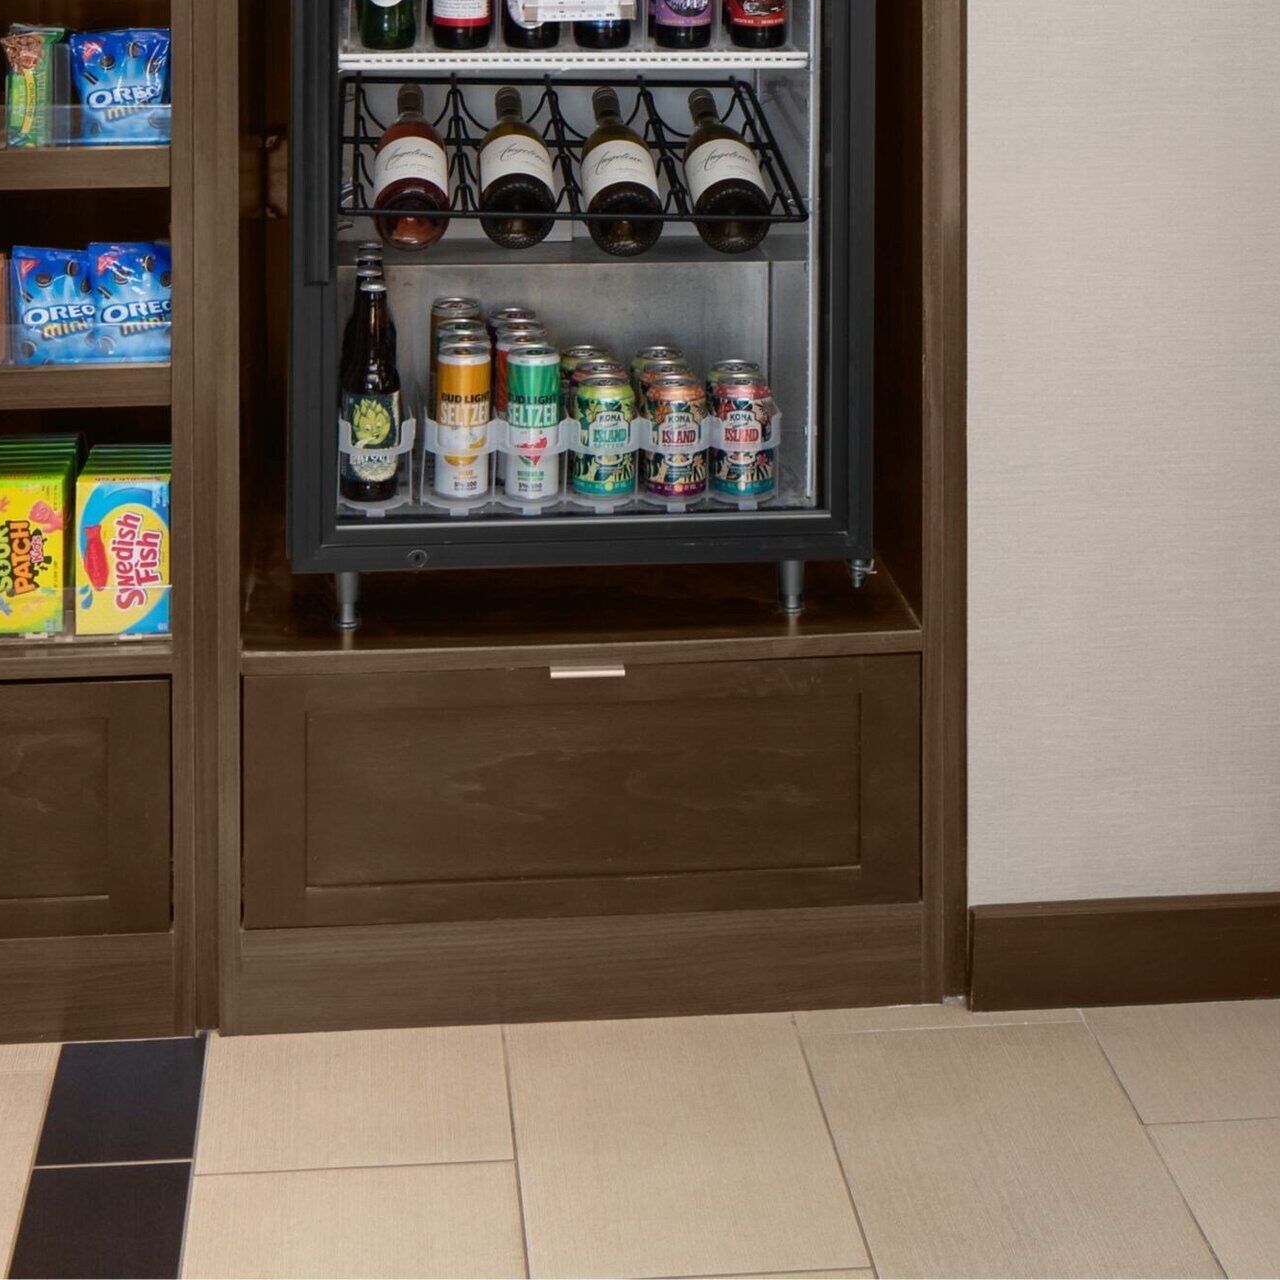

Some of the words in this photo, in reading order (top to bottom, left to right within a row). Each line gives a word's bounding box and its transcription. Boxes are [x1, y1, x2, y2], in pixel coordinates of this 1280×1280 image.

[24, 305, 96, 326] OREO
[508, 402, 557, 425] SELTZER
[599, 413, 621, 422] KONA
[668, 414, 691, 423] KONA
[729, 413, 752, 422] KONA
[593, 428, 627, 443] ISLAND
[662, 429, 696, 443] ISLAND
[724, 427, 759, 442] ISLAND
[10, 521, 39, 595] PATCH
[112, 513, 144, 609] Swedish
[136, 531, 161, 586] Fish
